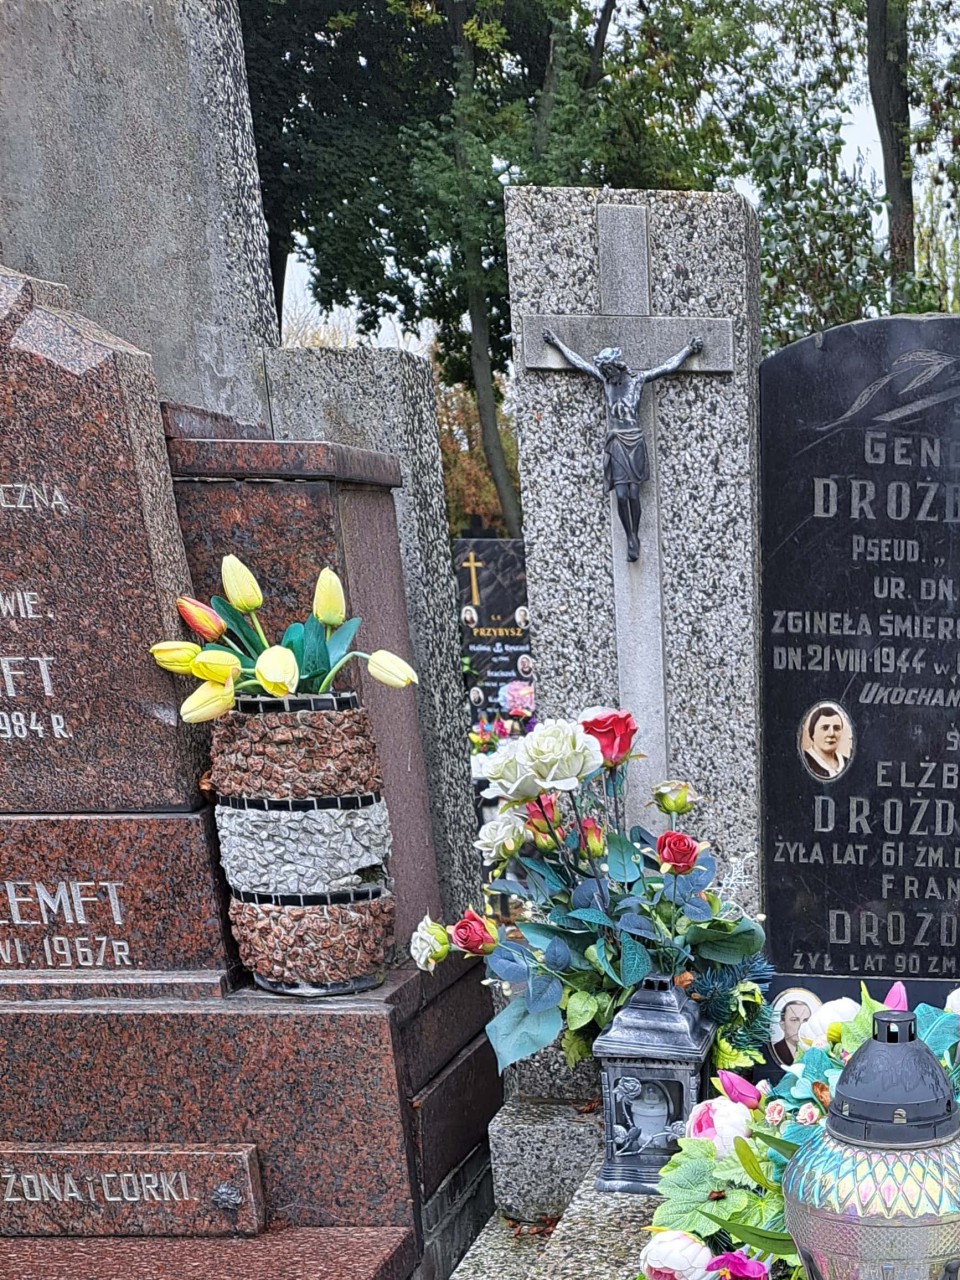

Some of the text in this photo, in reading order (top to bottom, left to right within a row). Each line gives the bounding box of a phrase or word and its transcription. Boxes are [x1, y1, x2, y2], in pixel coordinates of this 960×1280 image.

[852, 534, 926, 563] PSEUD.
[873, 575, 912, 600] UR.
[832, 842, 868, 866] LAT
[882, 842, 904, 866] 61
[849, 953, 887, 972] LAT
[895, 955, 920, 973] 90
